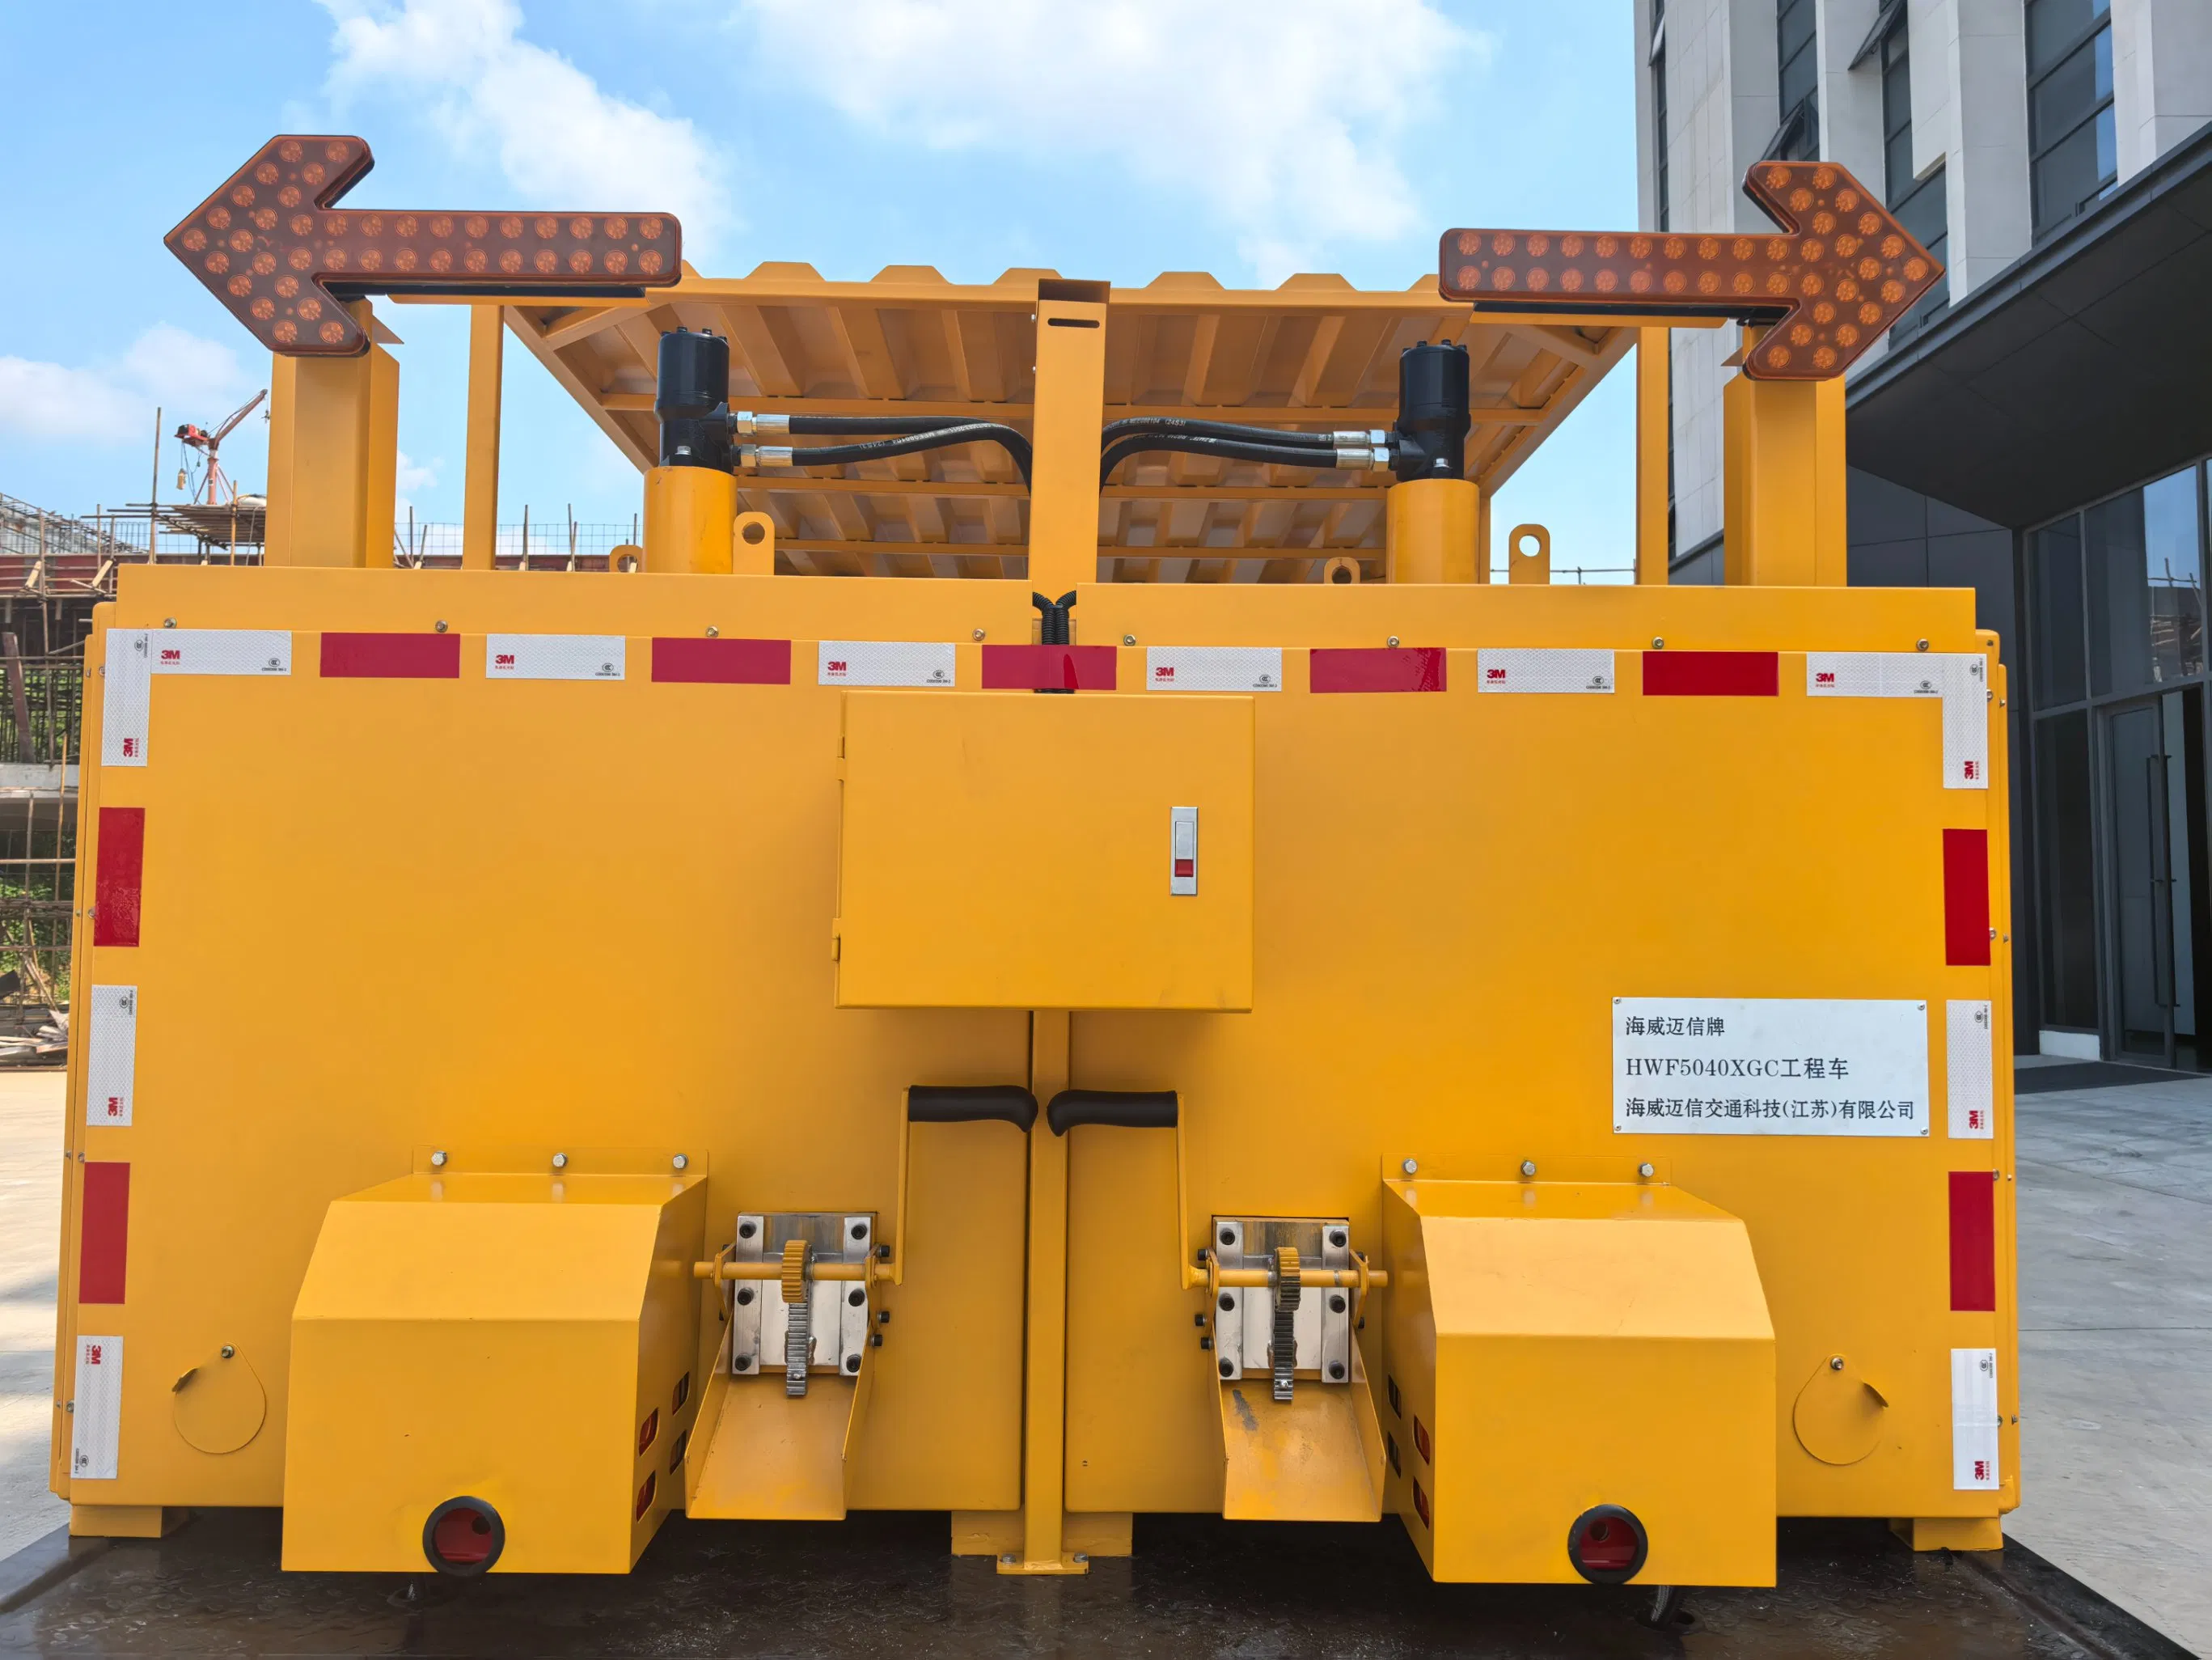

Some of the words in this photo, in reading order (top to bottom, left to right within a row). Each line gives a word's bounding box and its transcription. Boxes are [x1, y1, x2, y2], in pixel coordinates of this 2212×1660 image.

[162, 650, 180, 659] 3M
[496, 654, 514, 664] 3M
[828, 661, 847, 671] 3M
[1156, 667, 1174, 677] 3M
[1487, 669, 1506, 679] 3M
[1817, 672, 1835, 683] 3M
[123, 738, 133, 756] 3M
[1965, 760, 1974, 779] 3M
[1626, 1016, 1726, 1036] 海威迈信牌
[1626, 1057, 1849, 1079] HWF5040XGC工程车
[108, 1097, 118, 1116] 3M
[1626, 1097, 1914, 1120] 海威迈信交通科技(江苏)有限公司
[1969, 1110, 1978, 1129] 3M
[91, 1345, 101, 1365] 3M
[1975, 1461, 1985, 1480] 3M
